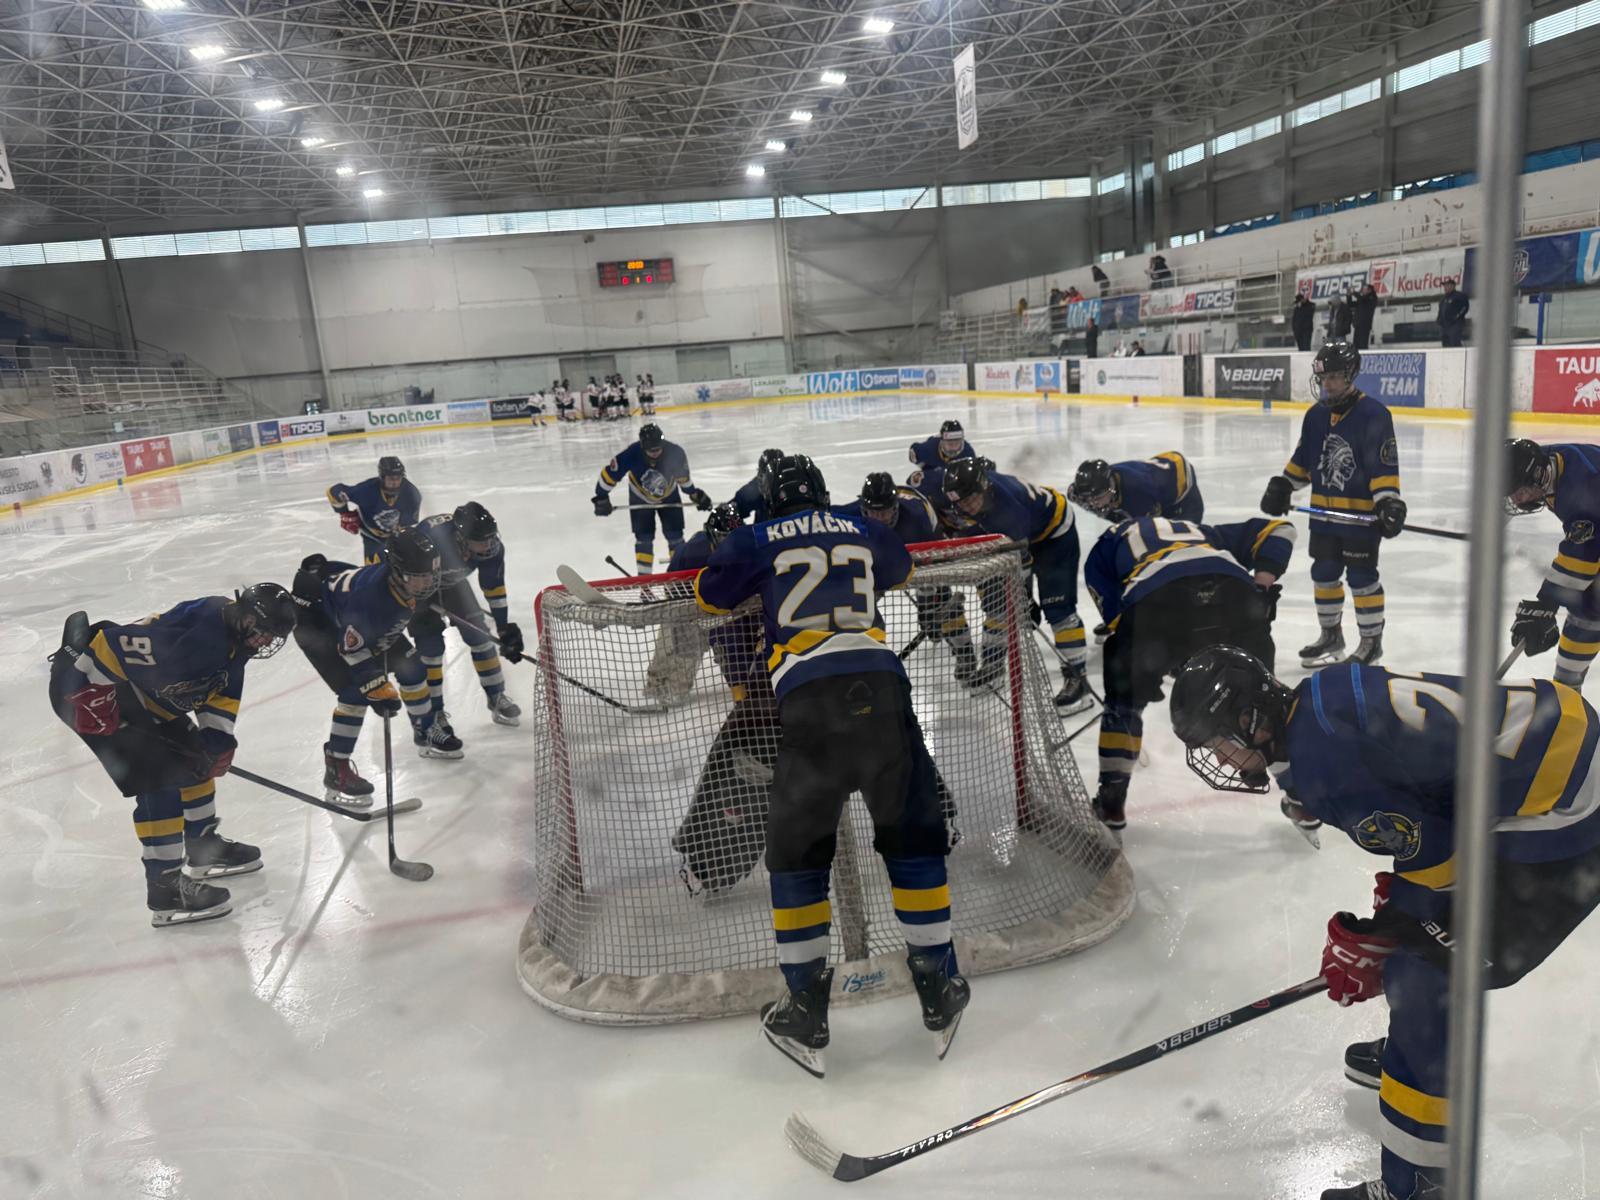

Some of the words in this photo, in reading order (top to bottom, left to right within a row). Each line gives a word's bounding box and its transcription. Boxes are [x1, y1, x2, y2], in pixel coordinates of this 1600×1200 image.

[1316, 274, 1365, 297] TIPOS
[1398, 272, 1461, 291] Kaufland
[1197, 290, 1234, 309] TIPOS
[809, 371, 857, 394] Wolt
[1232, 368, 1284, 381] BAUER
[1380, 377, 1418, 396] TEAM
[367, 409, 442, 427] brantner
[291, 422, 322, 434] TIPOS
[766, 510, 860, 541] KOVÁČIK
[773, 544, 875, 631] 23
[1170, 1013, 1233, 1047] BAUER
